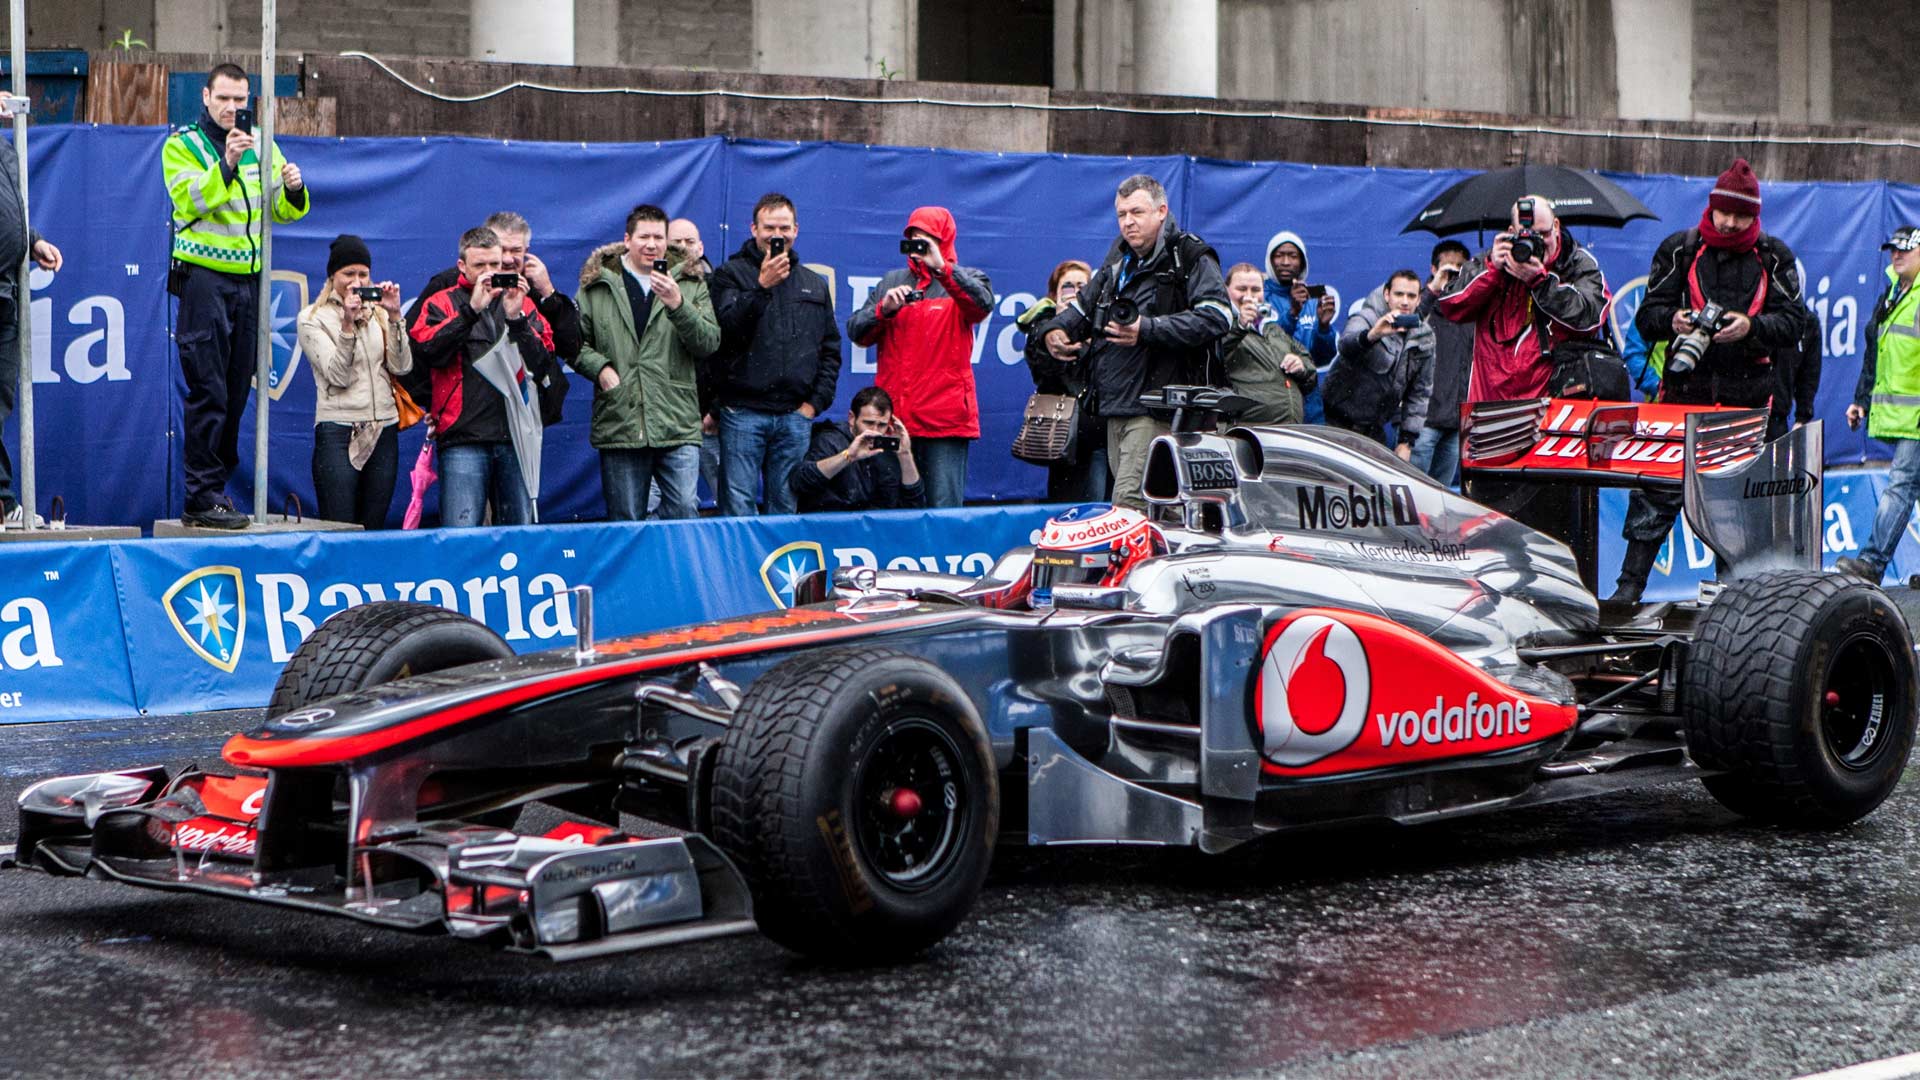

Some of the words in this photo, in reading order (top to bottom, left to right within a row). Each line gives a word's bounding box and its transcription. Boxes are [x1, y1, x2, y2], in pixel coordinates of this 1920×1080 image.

[30, 265, 132, 384] ia
[1191, 462, 1234, 481] BOSS
[1743, 473, 1806, 499] Lucozade
[1067, 517, 1130, 542] vodafone
[1296, 483, 1388, 530] Mobil
[1351, 538, 1471, 563] Mercedes-Benz
[256, 552, 577, 663] Bria
[0, 597, 64, 671] a
[1376, 691, 1532, 747] vodafone
